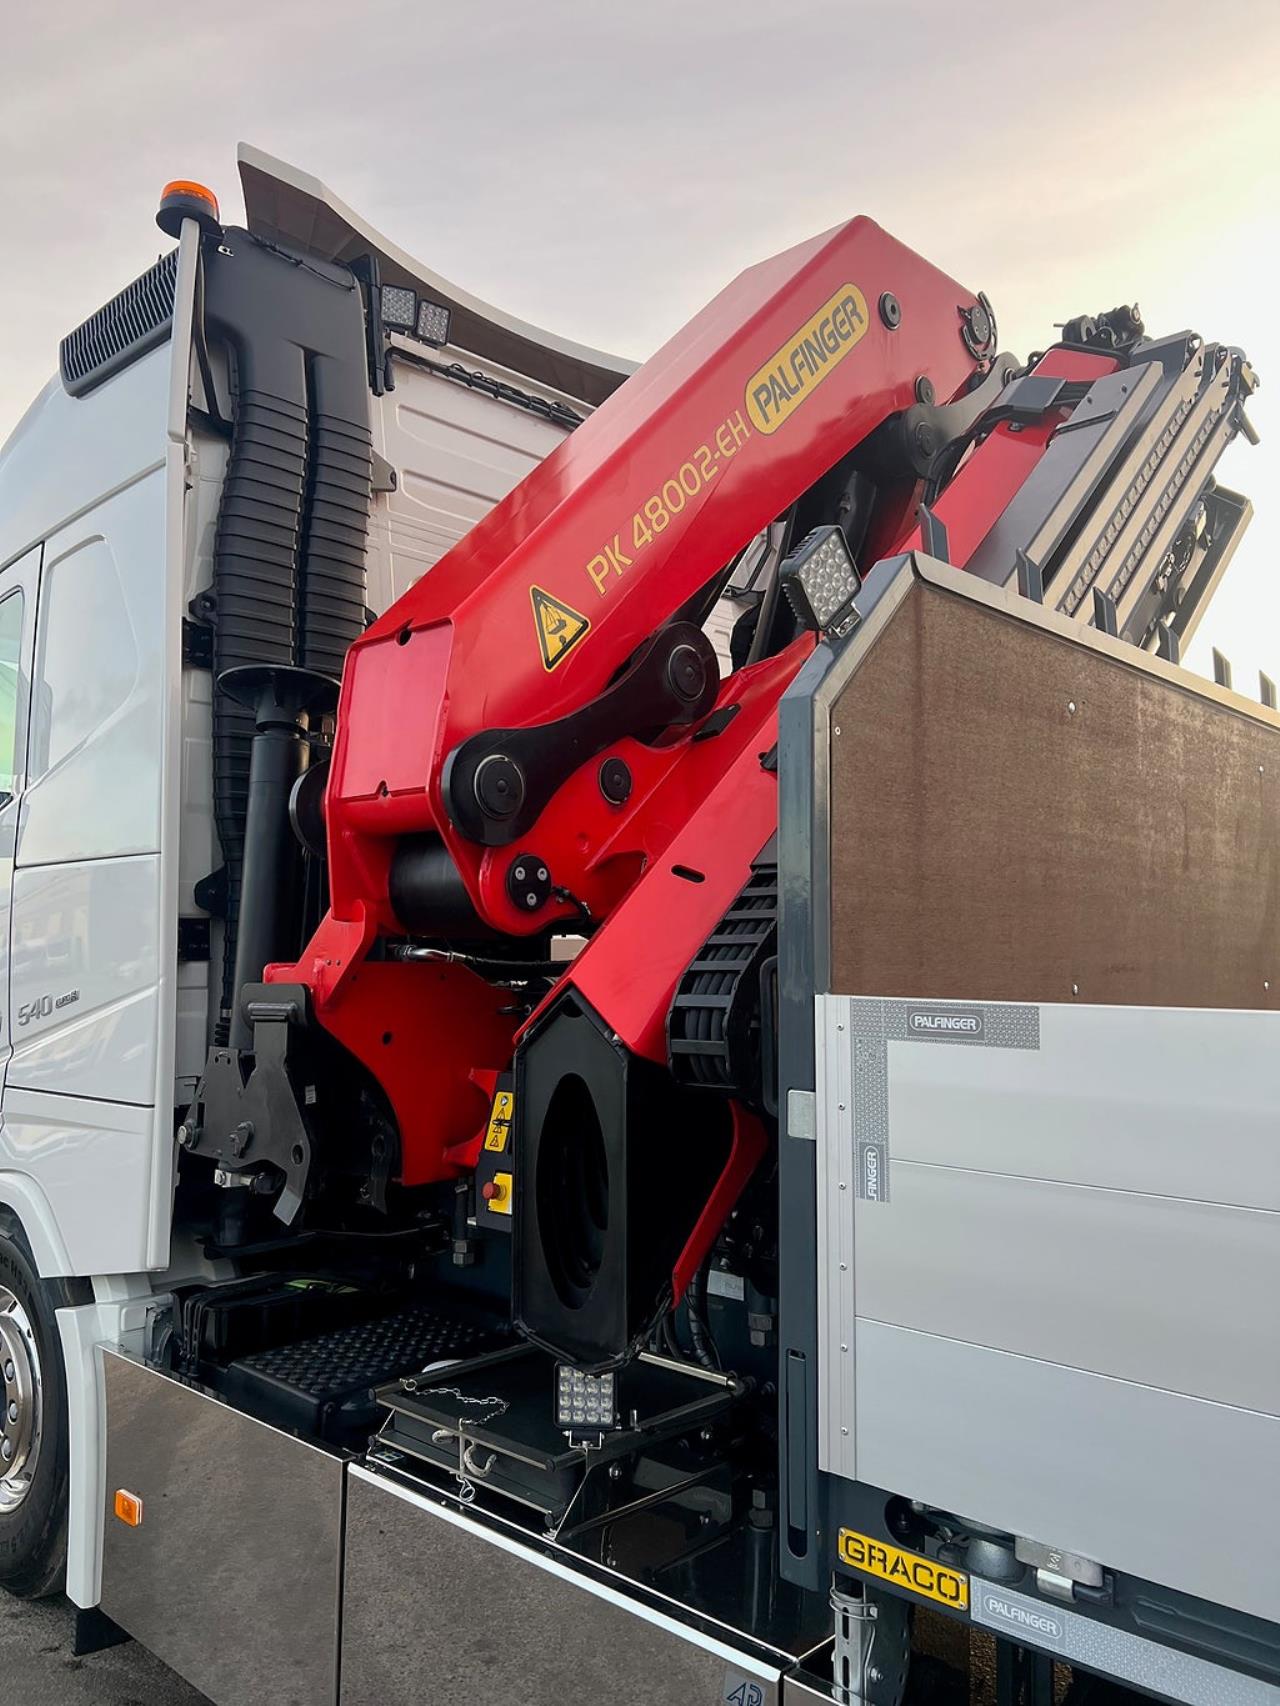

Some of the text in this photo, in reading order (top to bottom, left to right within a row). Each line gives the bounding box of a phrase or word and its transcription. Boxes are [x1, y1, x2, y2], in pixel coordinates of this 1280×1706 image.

[752, 295, 865, 425] PALFINGER
[585, 410, 751, 596] PK 48002-EH
[18, 995, 53, 1026] 540
[914, 1015, 977, 1031] PALFINGER
[845, 1534, 960, 1602] GRACO
[989, 1599, 1059, 1635] PALFINGER
